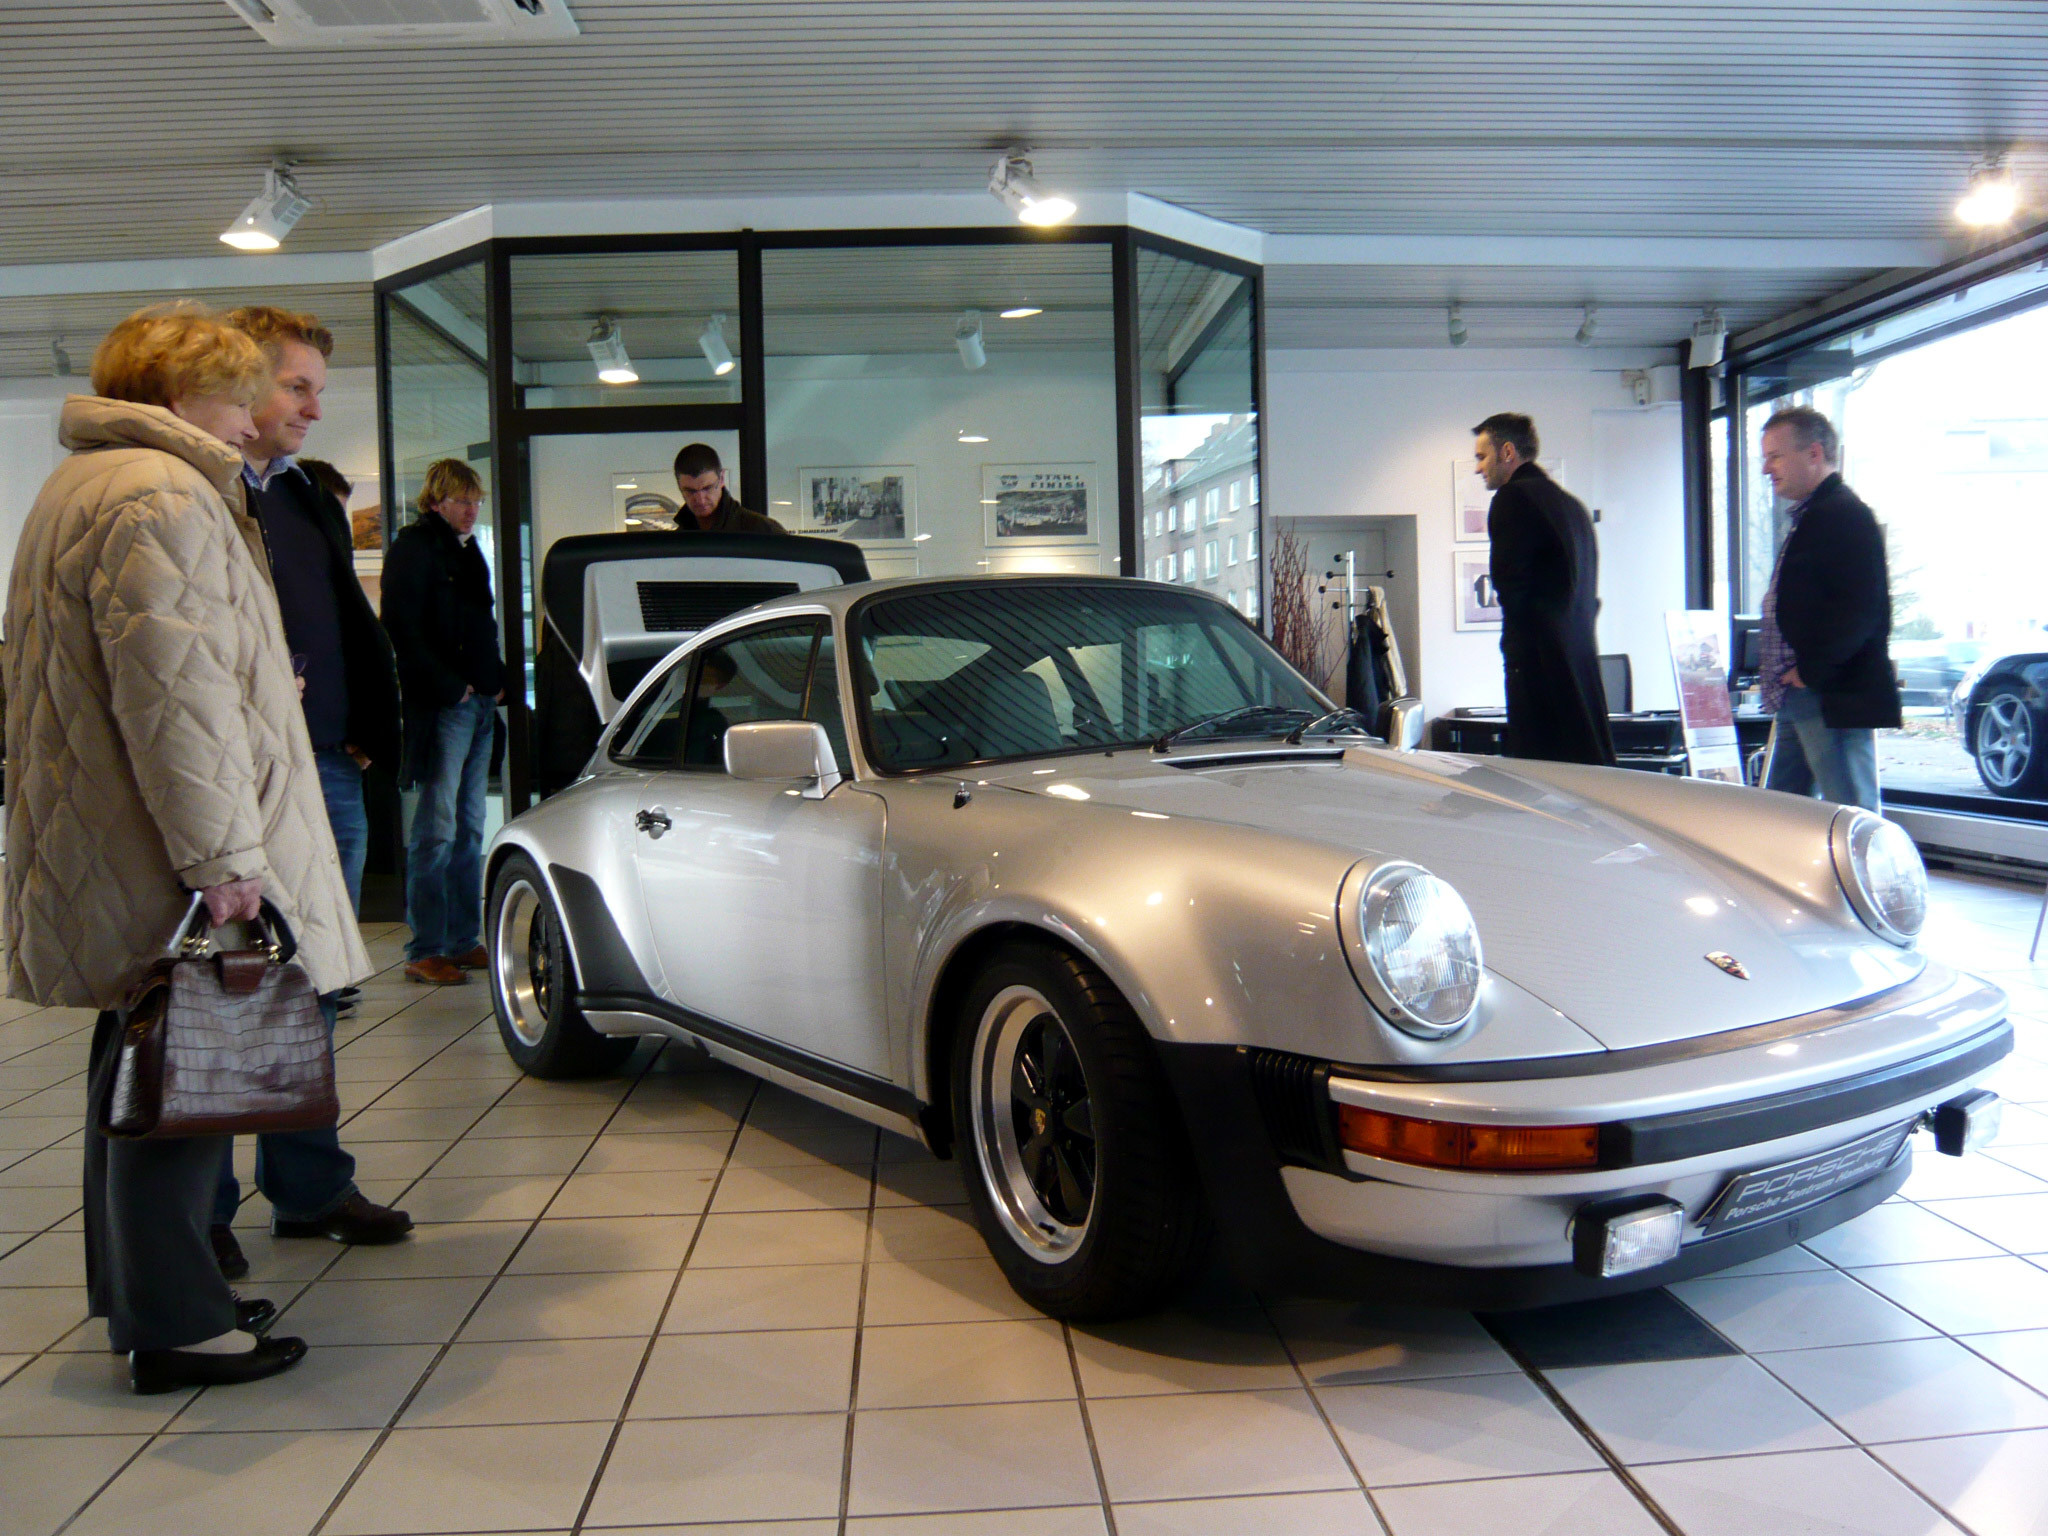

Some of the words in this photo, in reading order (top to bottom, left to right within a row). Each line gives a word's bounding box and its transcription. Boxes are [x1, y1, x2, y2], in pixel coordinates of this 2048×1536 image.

[1030, 481, 1085, 489] FINISH
[1724, 1195, 1780, 1221] Porsche
[1781, 1177, 1835, 1202] Zentrum
[1835, 1156, 1886, 1184] Hamburg
[1736, 1131, 1899, 1202] PORSCHE
